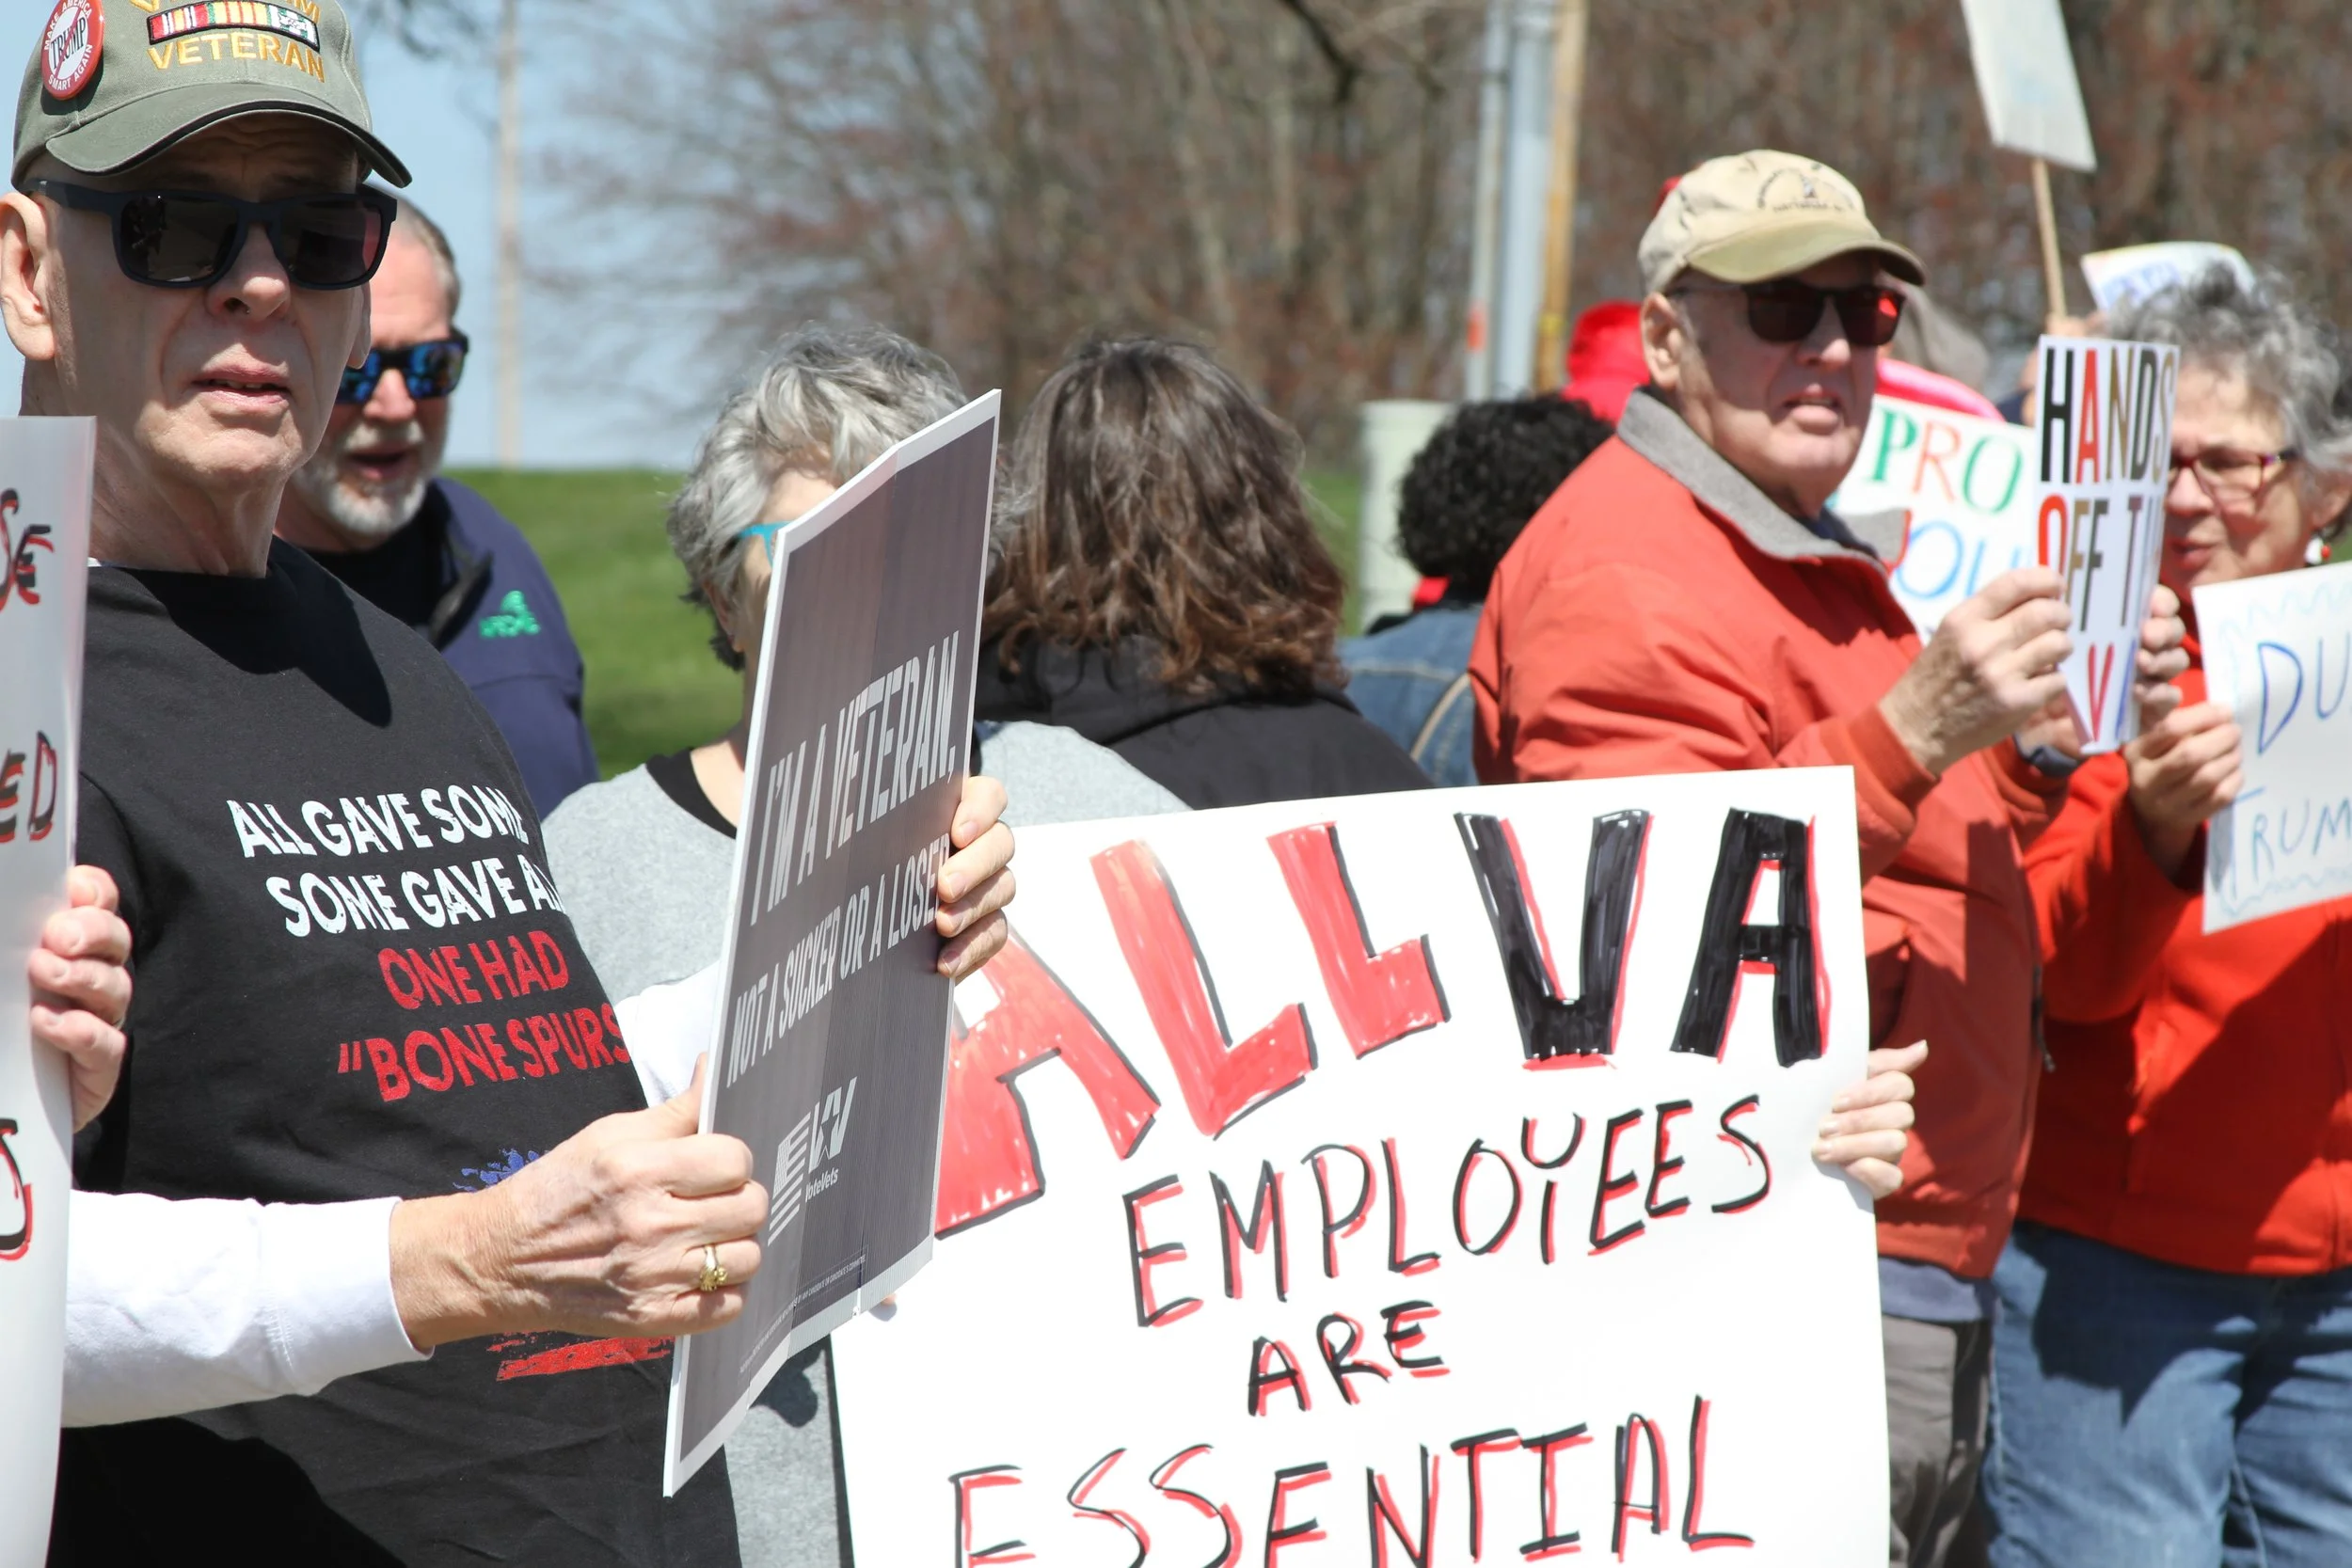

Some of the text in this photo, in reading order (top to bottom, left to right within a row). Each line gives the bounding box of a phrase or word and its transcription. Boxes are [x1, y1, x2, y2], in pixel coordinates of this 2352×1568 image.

[43, 12, 60, 51] MAKE
[48, 43, 93, 90] SMART AGAIN
[50, 17, 87, 70] TRUMP
[147, 31, 326, 84] VETERAN
[2041, 345, 2175, 484] HANDS
[227, 800, 318, 858] ALL
[301, 793, 434, 857] GAVE
[750, 740, 807, 927] I'M
[796, 722, 828, 886] A
[265, 872, 410, 938] SOME
[401, 857, 527, 927] GAVE
[377, 930, 570, 1009] ONE HAD
[726, 973, 769, 1089] NOT
[762, 962, 780, 1057] A
[778, 905, 841, 1039] SUCKER
[839, 884, 870, 981] OR
[868, 873, 886, 963] A
[934, 806, 1833, 1241] ALL VA
[804, 1167, 839, 1203] VoteVets
[1120, 1094, 1772, 1328] EMPLOYEES
[1248, 1300, 1452, 1418] ARE
[948, 1394, 1756, 1568] ESSENTIAL
